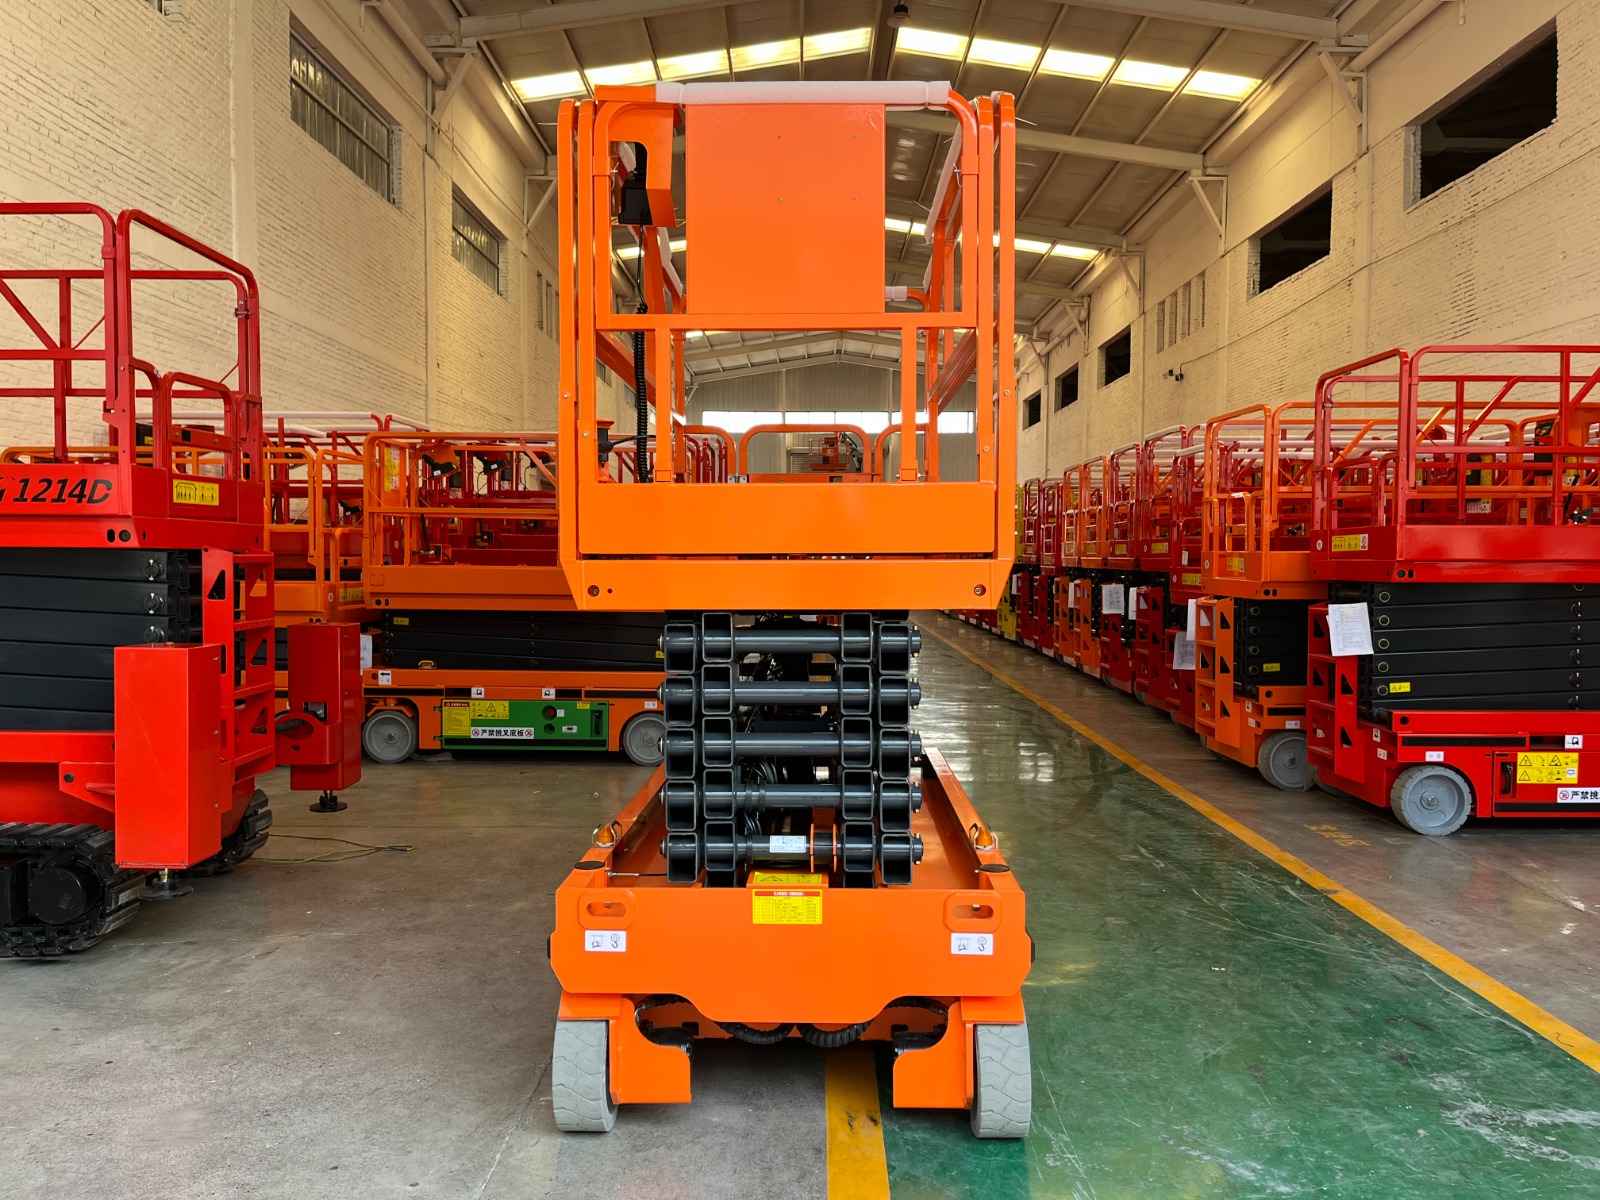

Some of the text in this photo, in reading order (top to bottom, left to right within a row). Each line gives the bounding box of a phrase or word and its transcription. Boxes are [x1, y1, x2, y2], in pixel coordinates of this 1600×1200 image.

[13, 477, 113, 504] 1214D
[481, 728, 525, 737] 严禁挑叉底板
[1571, 790, 1600, 800] 严禁挑
